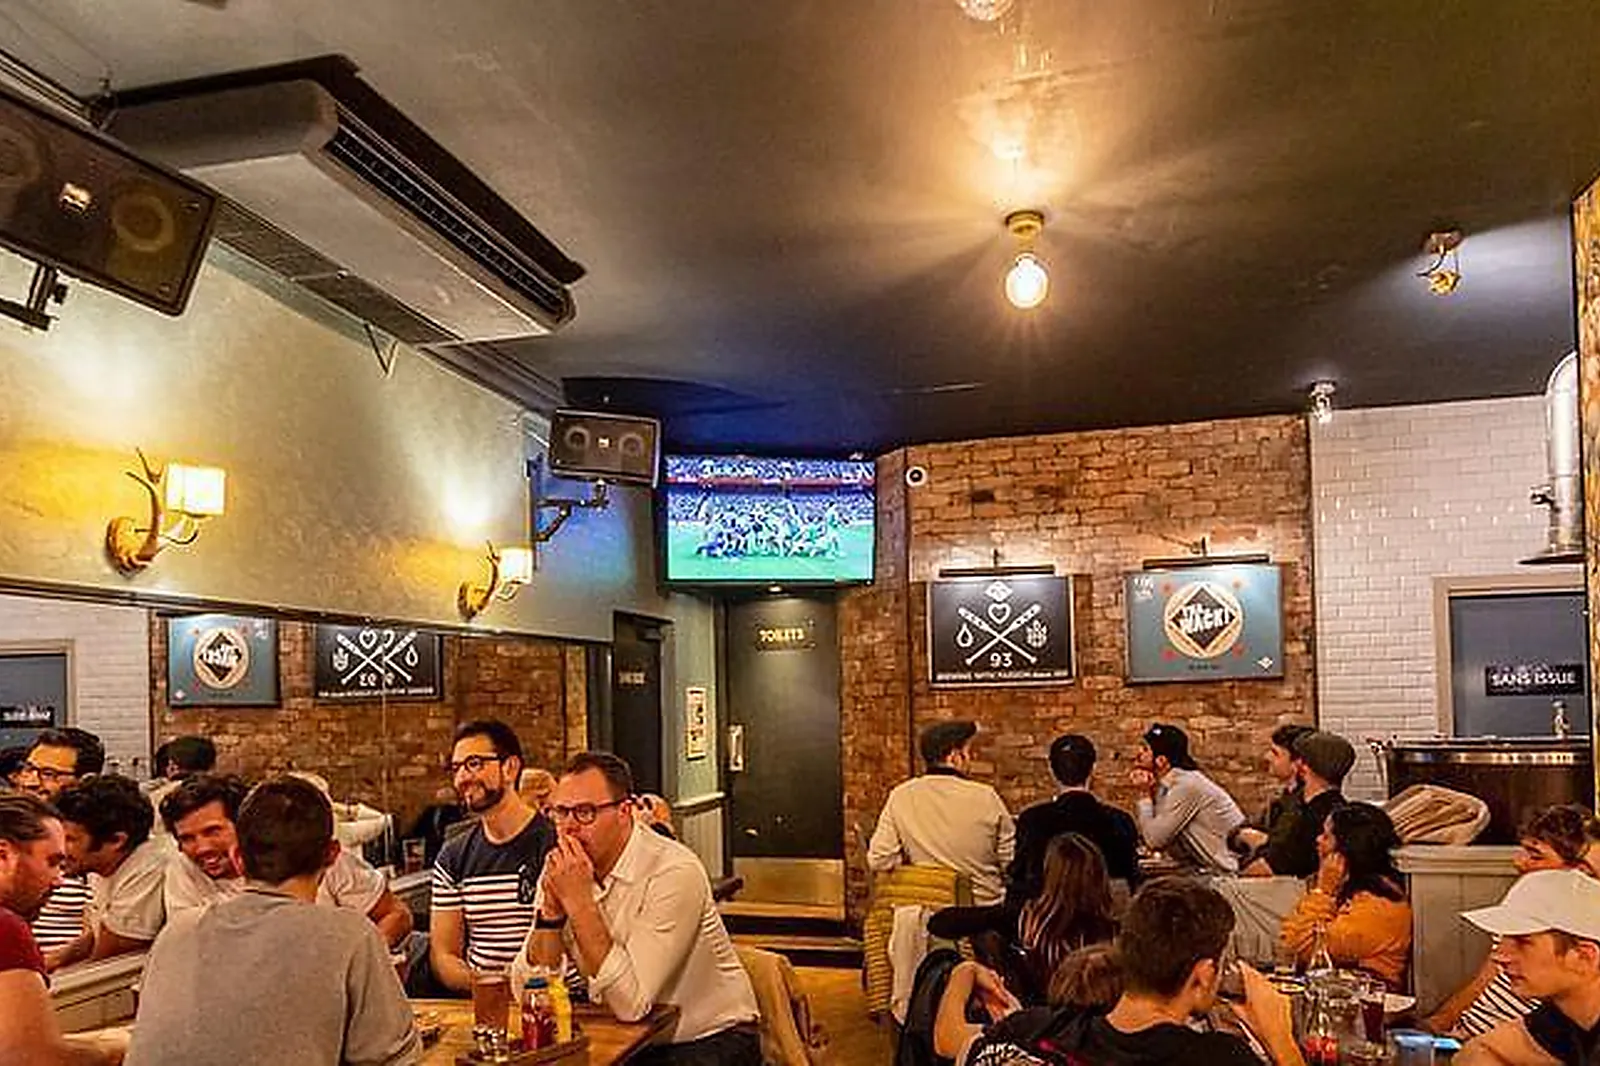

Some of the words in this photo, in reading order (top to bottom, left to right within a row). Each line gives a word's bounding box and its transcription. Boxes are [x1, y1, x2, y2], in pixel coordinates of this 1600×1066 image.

[760, 628, 804, 641] TOILETS
[990, 652, 1012, 667] 93
[1492, 672, 1531, 686] SANS
[1534, 672, 1576, 685] ISSUE
